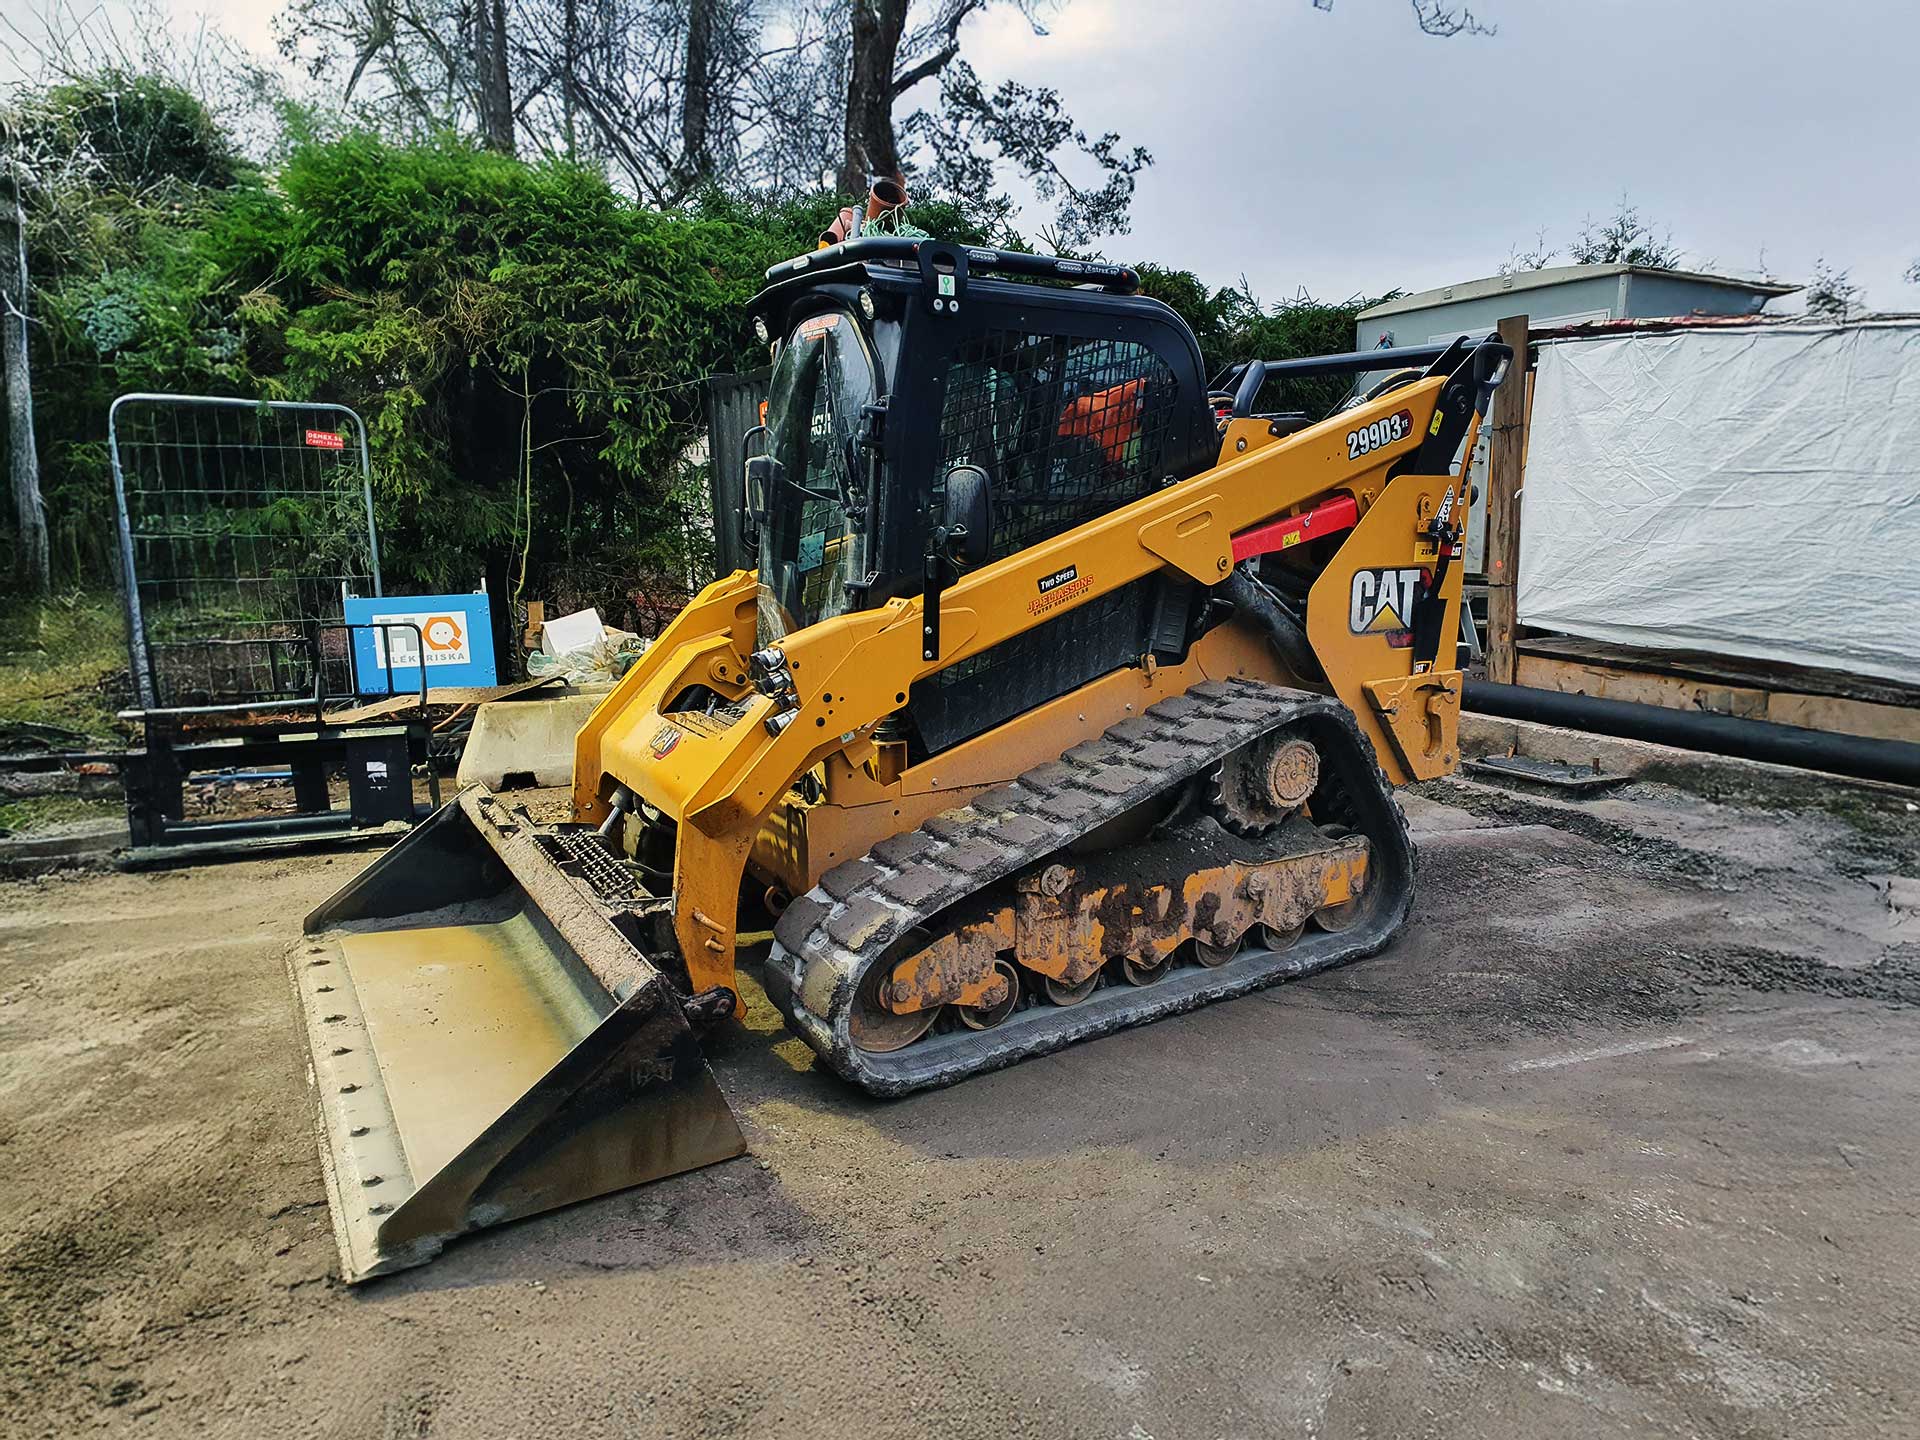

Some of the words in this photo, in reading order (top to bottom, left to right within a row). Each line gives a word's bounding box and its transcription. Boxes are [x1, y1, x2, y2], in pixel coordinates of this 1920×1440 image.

[1346, 413, 1402, 460] 299D3
[1350, 569, 1421, 632] CAT
[386, 653, 465, 664] LEKRISKA
